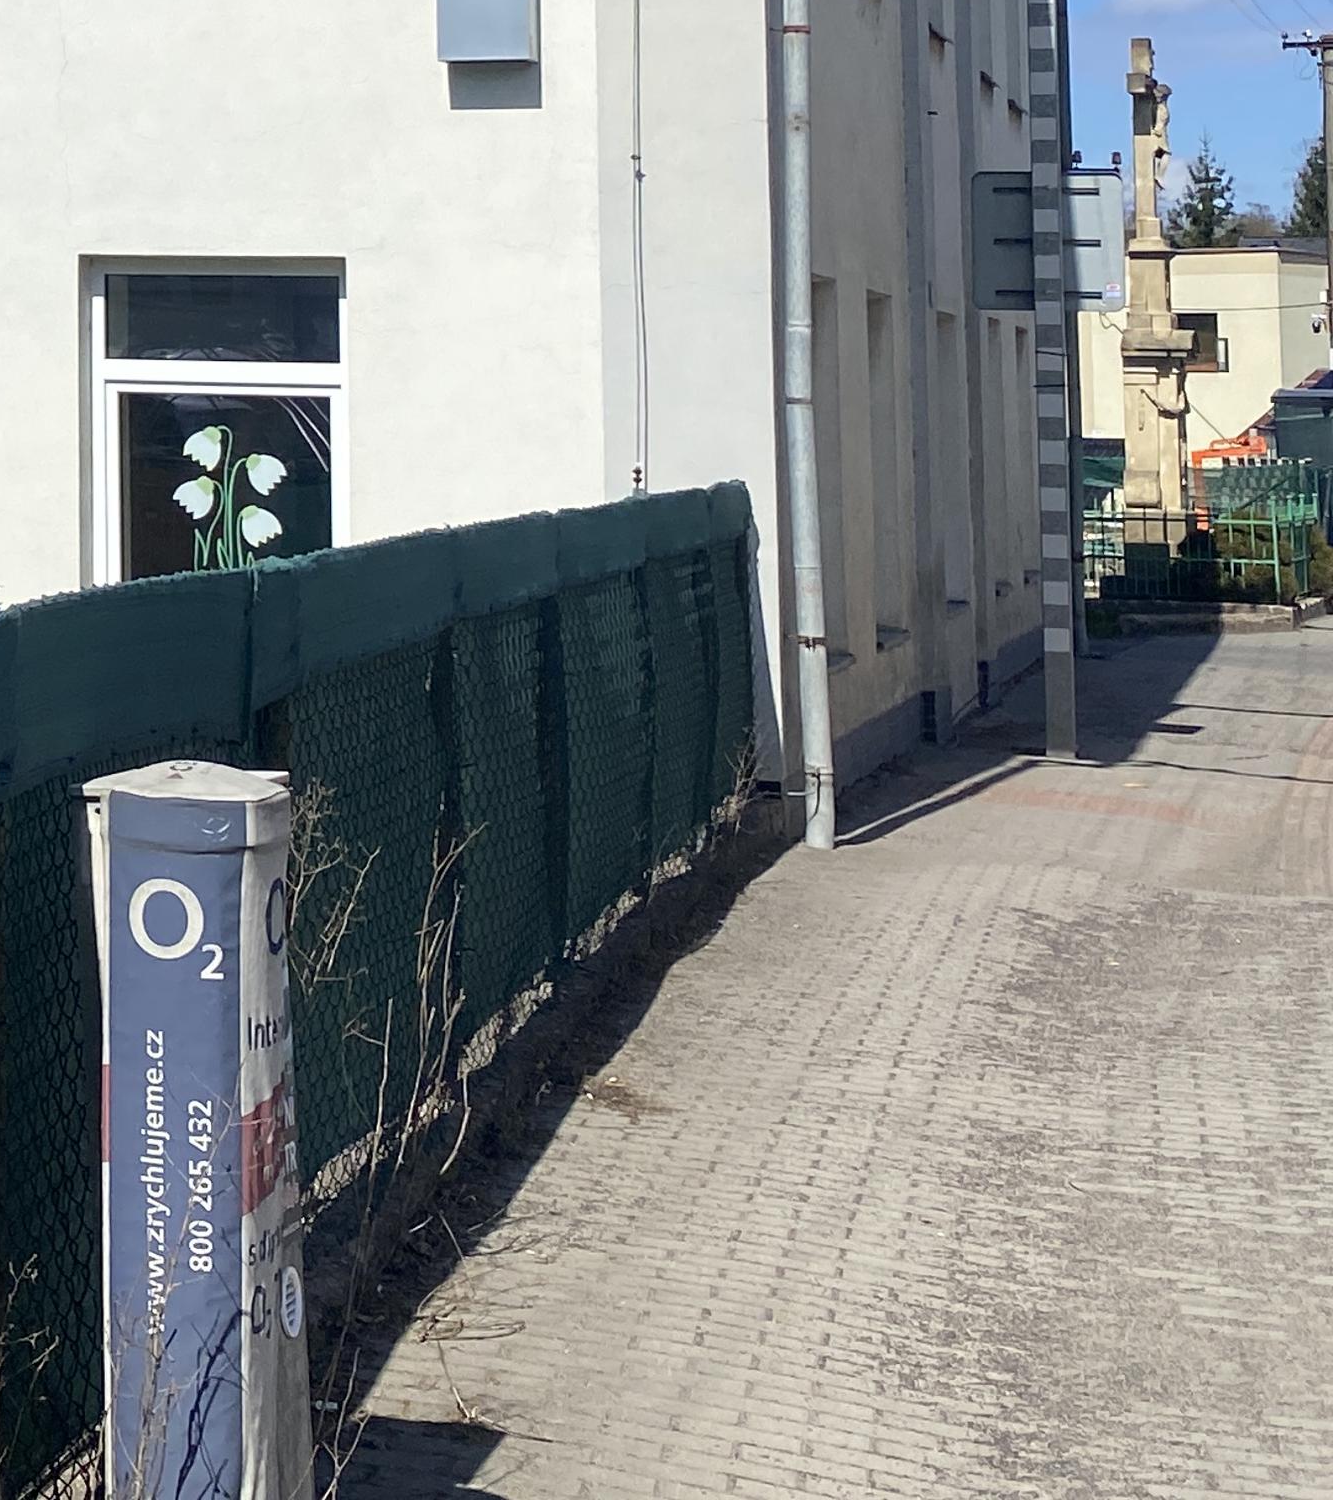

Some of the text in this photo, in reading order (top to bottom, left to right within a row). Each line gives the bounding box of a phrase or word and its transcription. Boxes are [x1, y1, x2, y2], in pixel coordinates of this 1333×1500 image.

[128, 878, 225, 980] O2
[188, 1100, 213, 1273] 800 265 432
